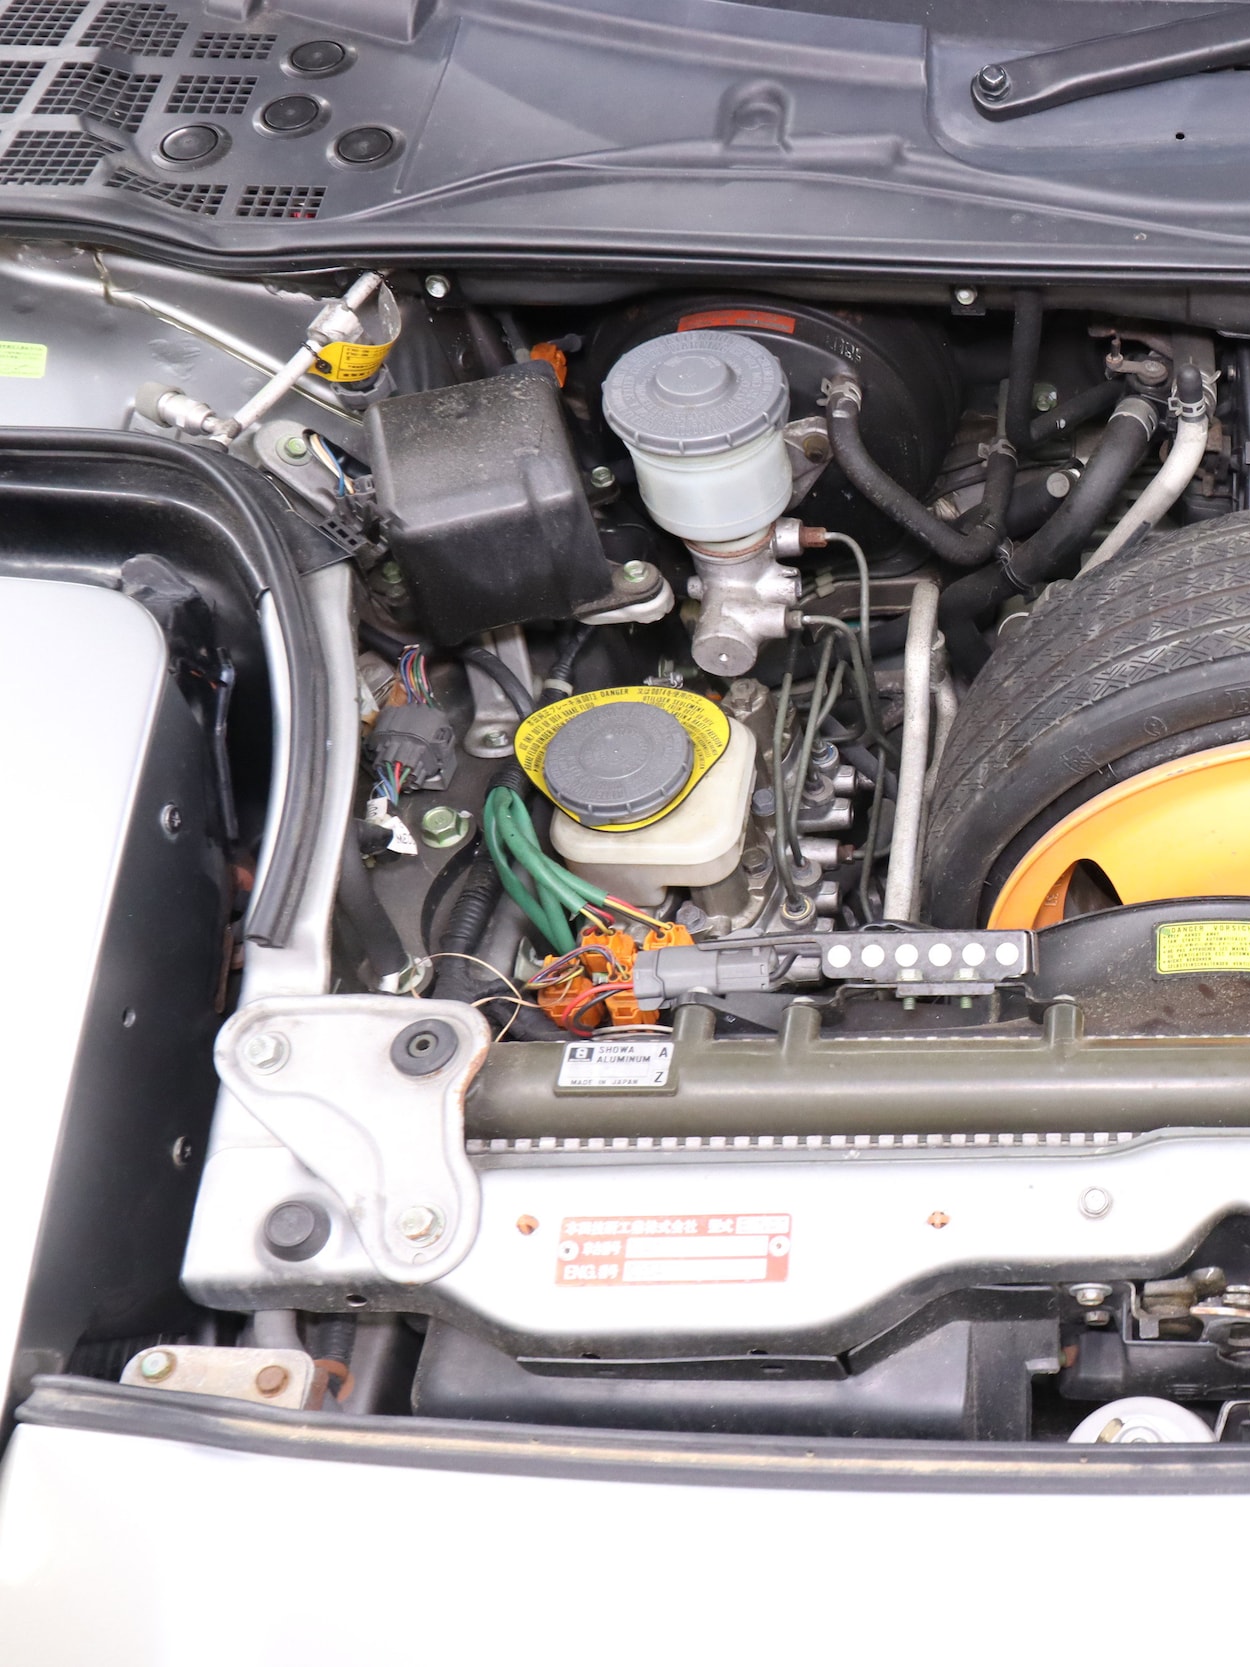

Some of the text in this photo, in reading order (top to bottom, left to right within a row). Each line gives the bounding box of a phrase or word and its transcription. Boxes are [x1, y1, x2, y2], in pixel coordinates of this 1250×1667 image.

[600, 688, 629, 698] DANGER
[1171, 925, 1204, 933] DANGER
[658, 1047, 668, 1058] A
[654, 1072, 664, 1083] Z
